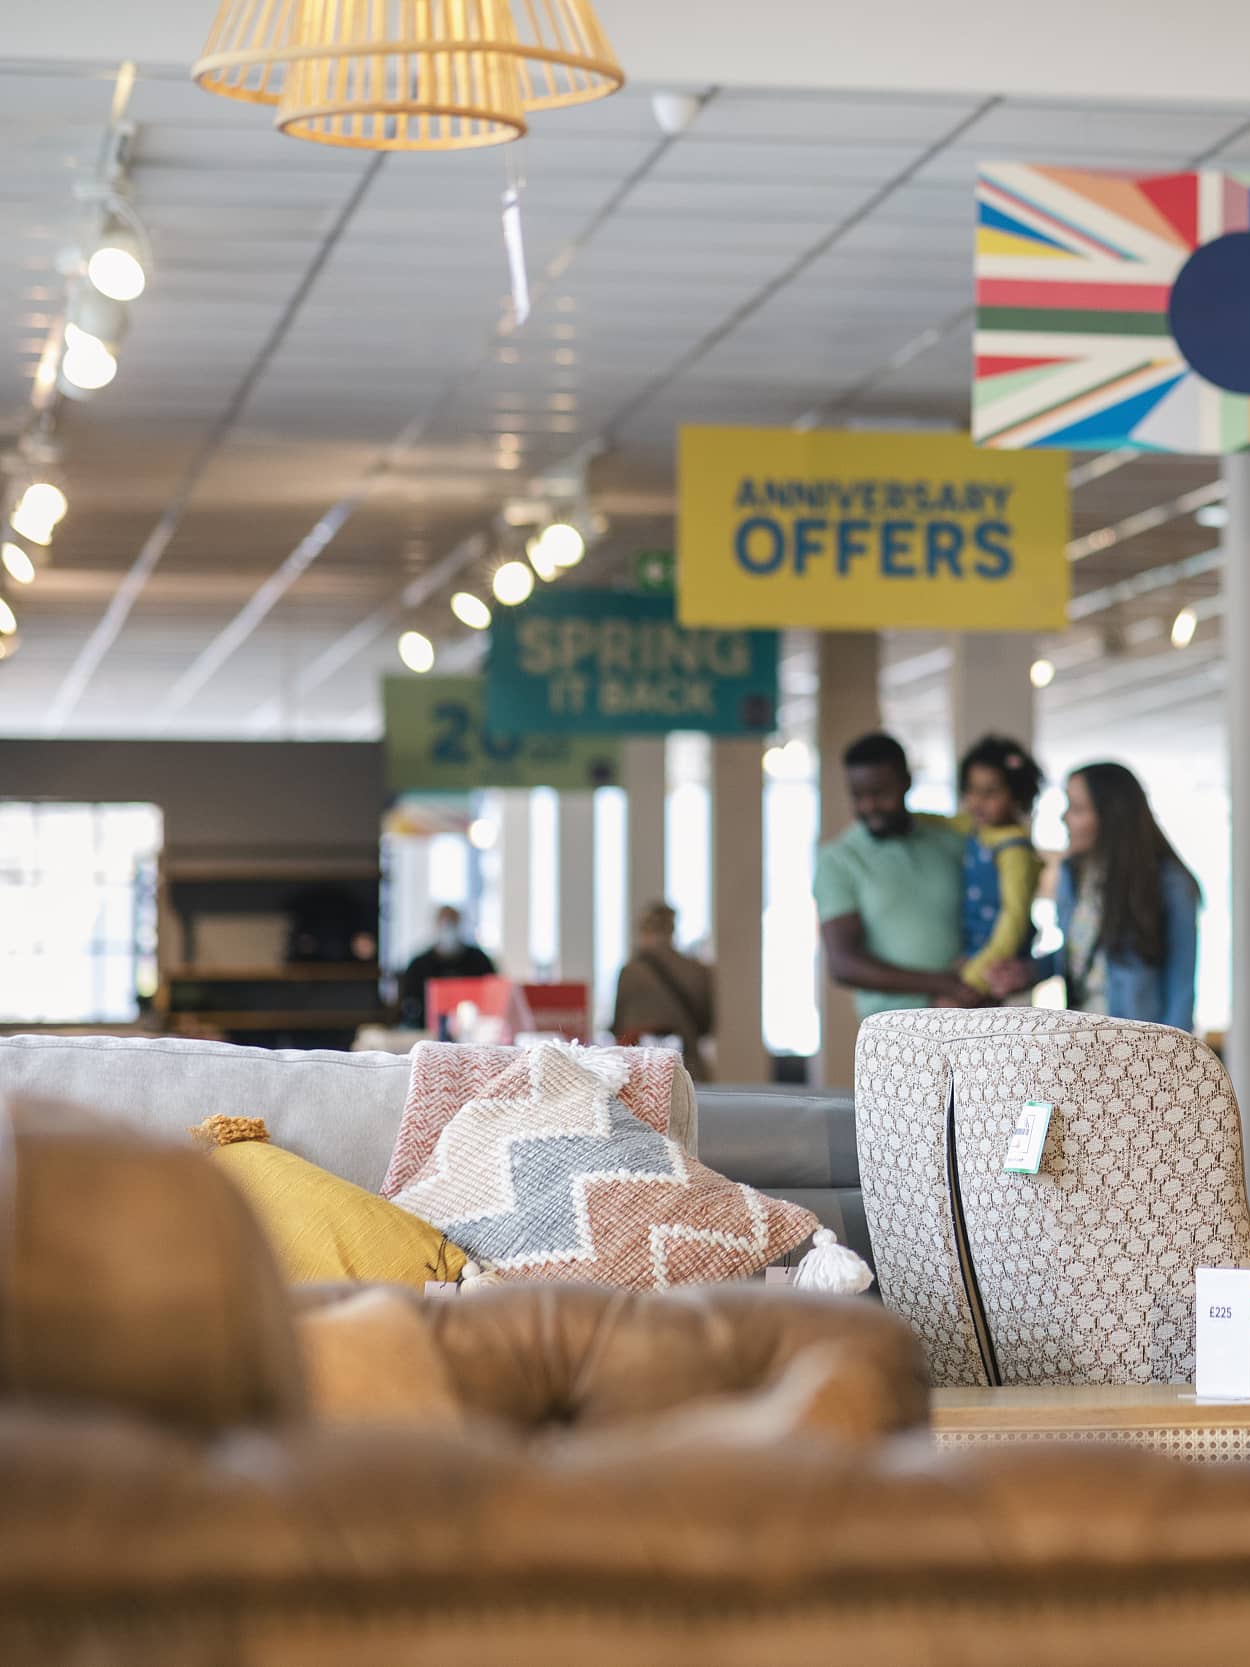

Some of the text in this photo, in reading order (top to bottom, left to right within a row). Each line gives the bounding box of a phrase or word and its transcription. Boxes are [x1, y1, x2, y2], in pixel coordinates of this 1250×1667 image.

[737, 477, 1012, 513] ANNIVERSARY
[735, 516, 1013, 579] OFFERS
[519, 616, 749, 675] SPRING
[550, 676, 714, 716] IT BACK
[1209, 1306, 1232, 1319] £225
